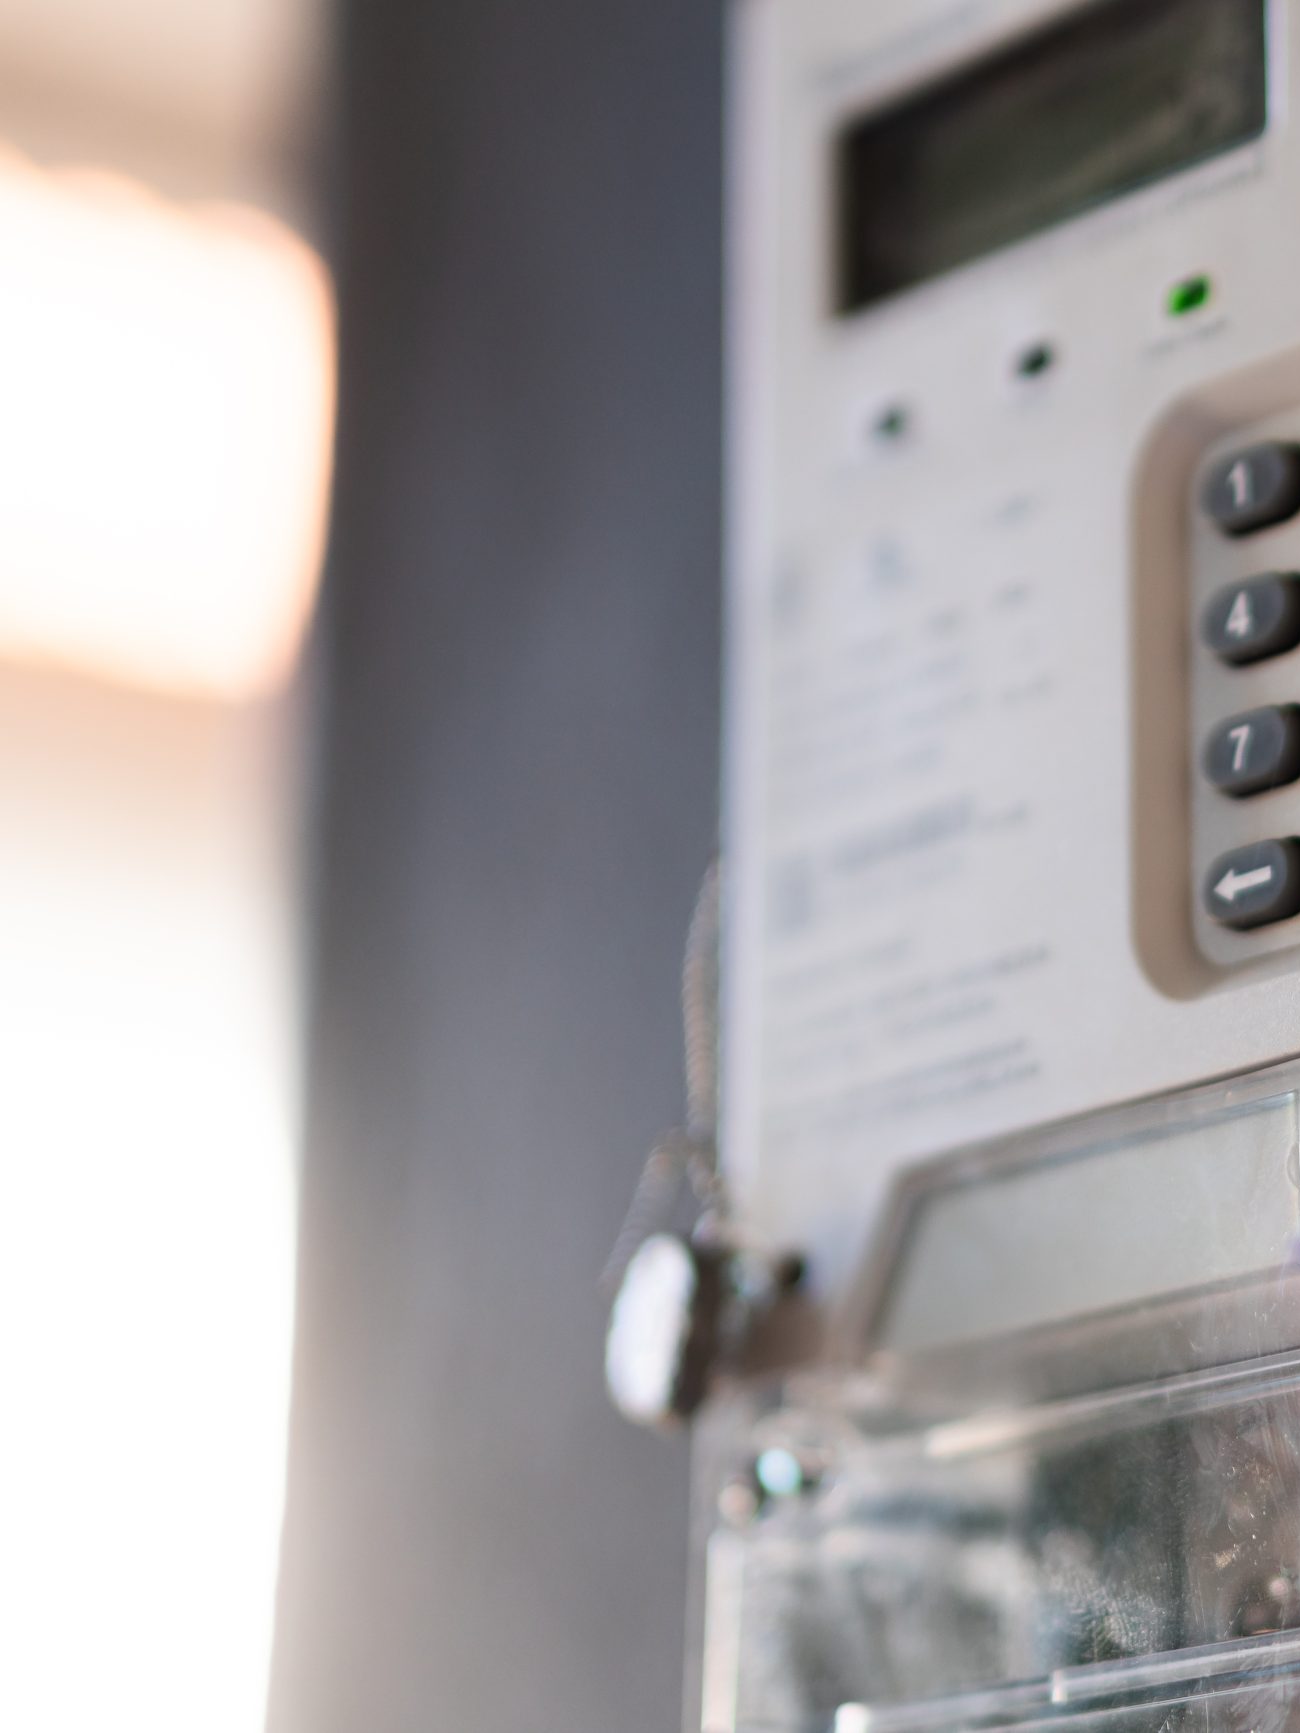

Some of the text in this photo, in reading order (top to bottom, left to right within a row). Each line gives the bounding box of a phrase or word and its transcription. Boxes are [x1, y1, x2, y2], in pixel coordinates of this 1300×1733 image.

[1228, 461, 1249, 506] 1
[1226, 592, 1251, 637] 4
[1229, 724, 1251, 771] 7
